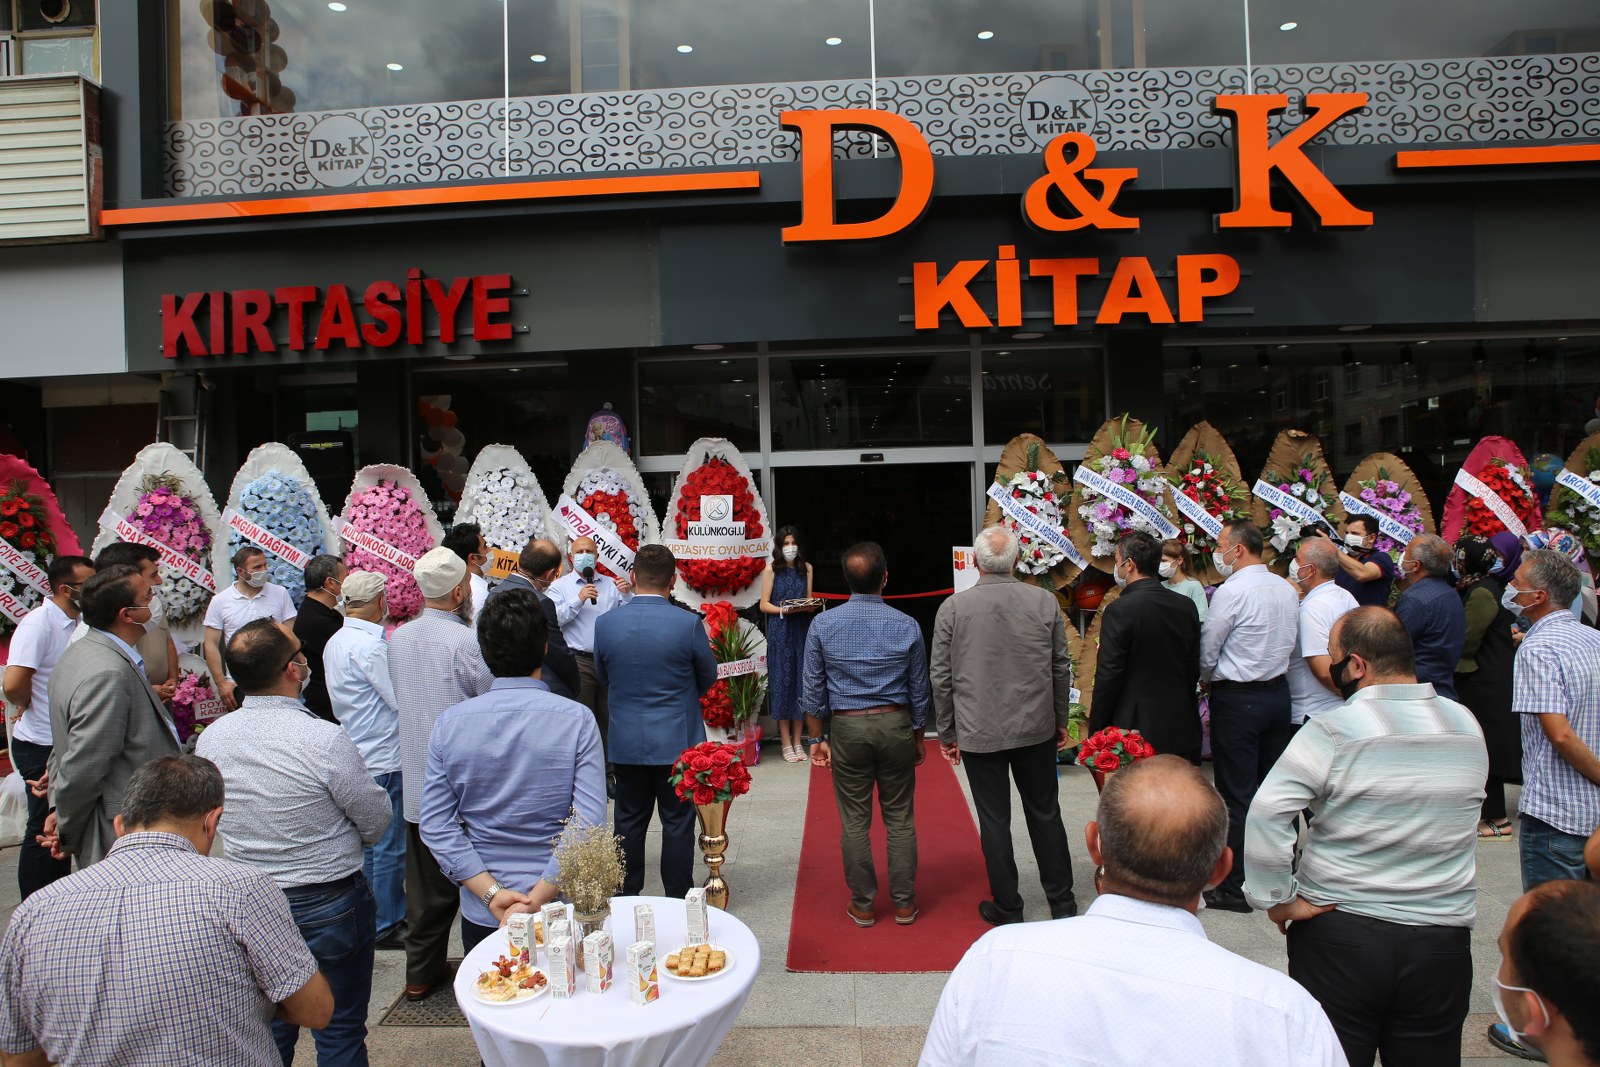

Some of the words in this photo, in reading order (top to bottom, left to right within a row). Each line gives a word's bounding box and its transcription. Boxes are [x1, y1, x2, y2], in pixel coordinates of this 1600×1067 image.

[1036, 121, 1087, 134] KİTAP
[318, 158, 364, 171] KİTAP
[781, 108, 935, 243] D
[1024, 131, 1140, 232] &
[1215, 93, 1374, 228] K
[913, 244, 1241, 330] KİTAP
[161, 267, 513, 358] KIRTASİYE
[1257, 484, 1281, 501] MUSTAFA
[1562, 474, 1590, 492] ARON
[1201, 517, 1222, 535] ARDEŞE
[1343, 496, 1361, 513] FARUK
[1386, 522, 1400, 534] CHP
[117, 521, 145, 544] ALPAY
[259, 533, 300, 563] DAĞITIM
[718, 542, 769, 555] OYUNCAK
[0, 540, 22, 565] CİYE
[16, 561, 41, 581] ZİYA
